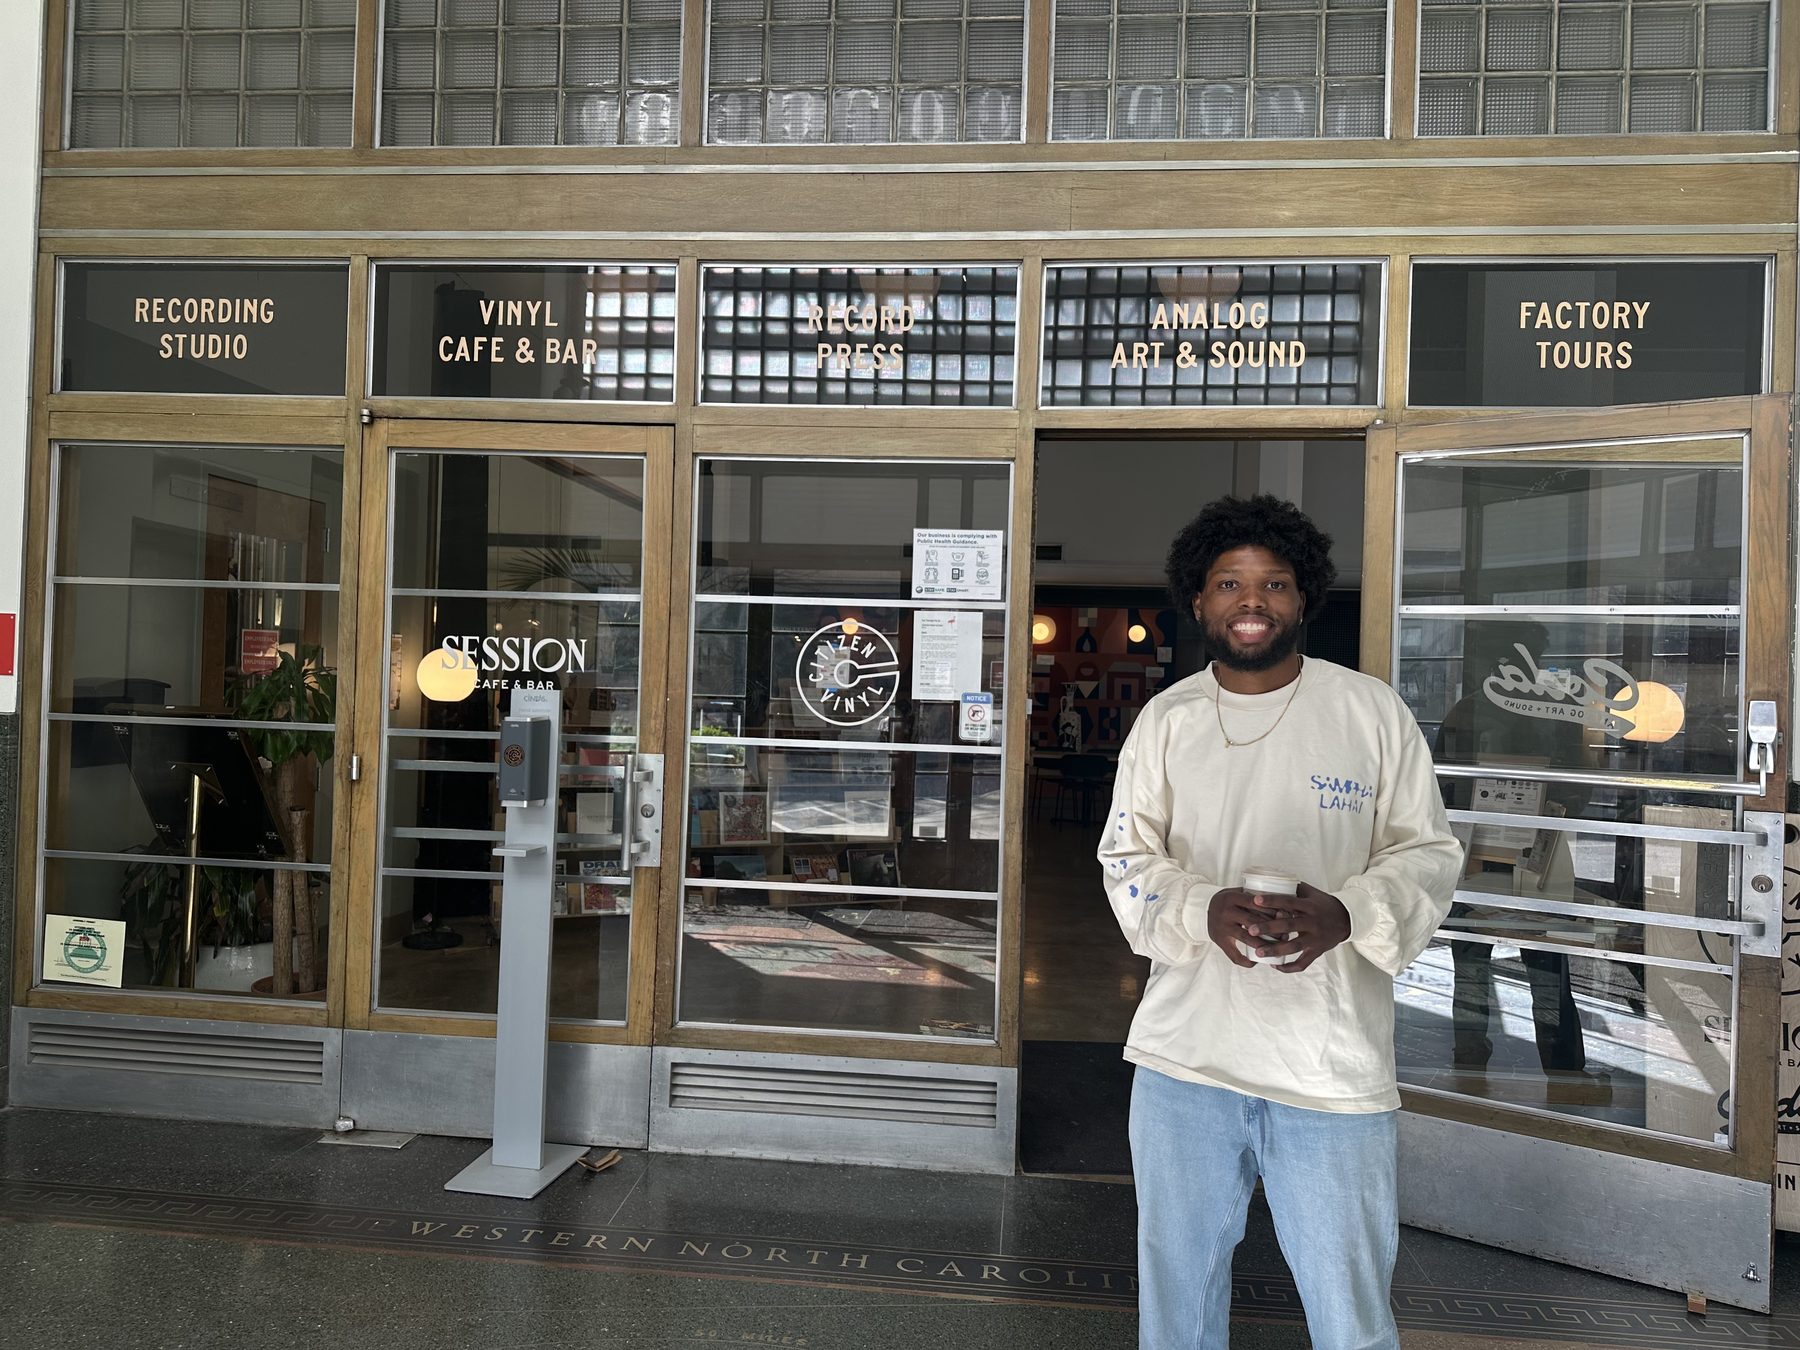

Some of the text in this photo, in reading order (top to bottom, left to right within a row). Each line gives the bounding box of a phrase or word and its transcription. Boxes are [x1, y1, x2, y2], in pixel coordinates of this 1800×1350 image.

[135, 297, 275, 324] RECORDING
[479, 300, 558, 328] VINYL
[808, 303, 915, 332] RECORD
[1152, 302, 1268, 330] ANALOG
[1519, 301, 1651, 330] FACTORY
[159, 333, 248, 360] STUDIO
[439, 336, 598, 366] CAFE & BAR
[817, 343, 905, 371] PRESS
[1111, 341, 1306, 369] ART & SOUND
[1536, 341, 1633, 370] TOURS
[441, 635, 588, 674] SESSION
[808, 634, 877, 682] CITIZEN
[473, 678, 554, 691] CAFE & BAR
[820, 686, 883, 713] VINYL
[410, 1220, 1138, 1291] WESTERN NORTH CAROLI
